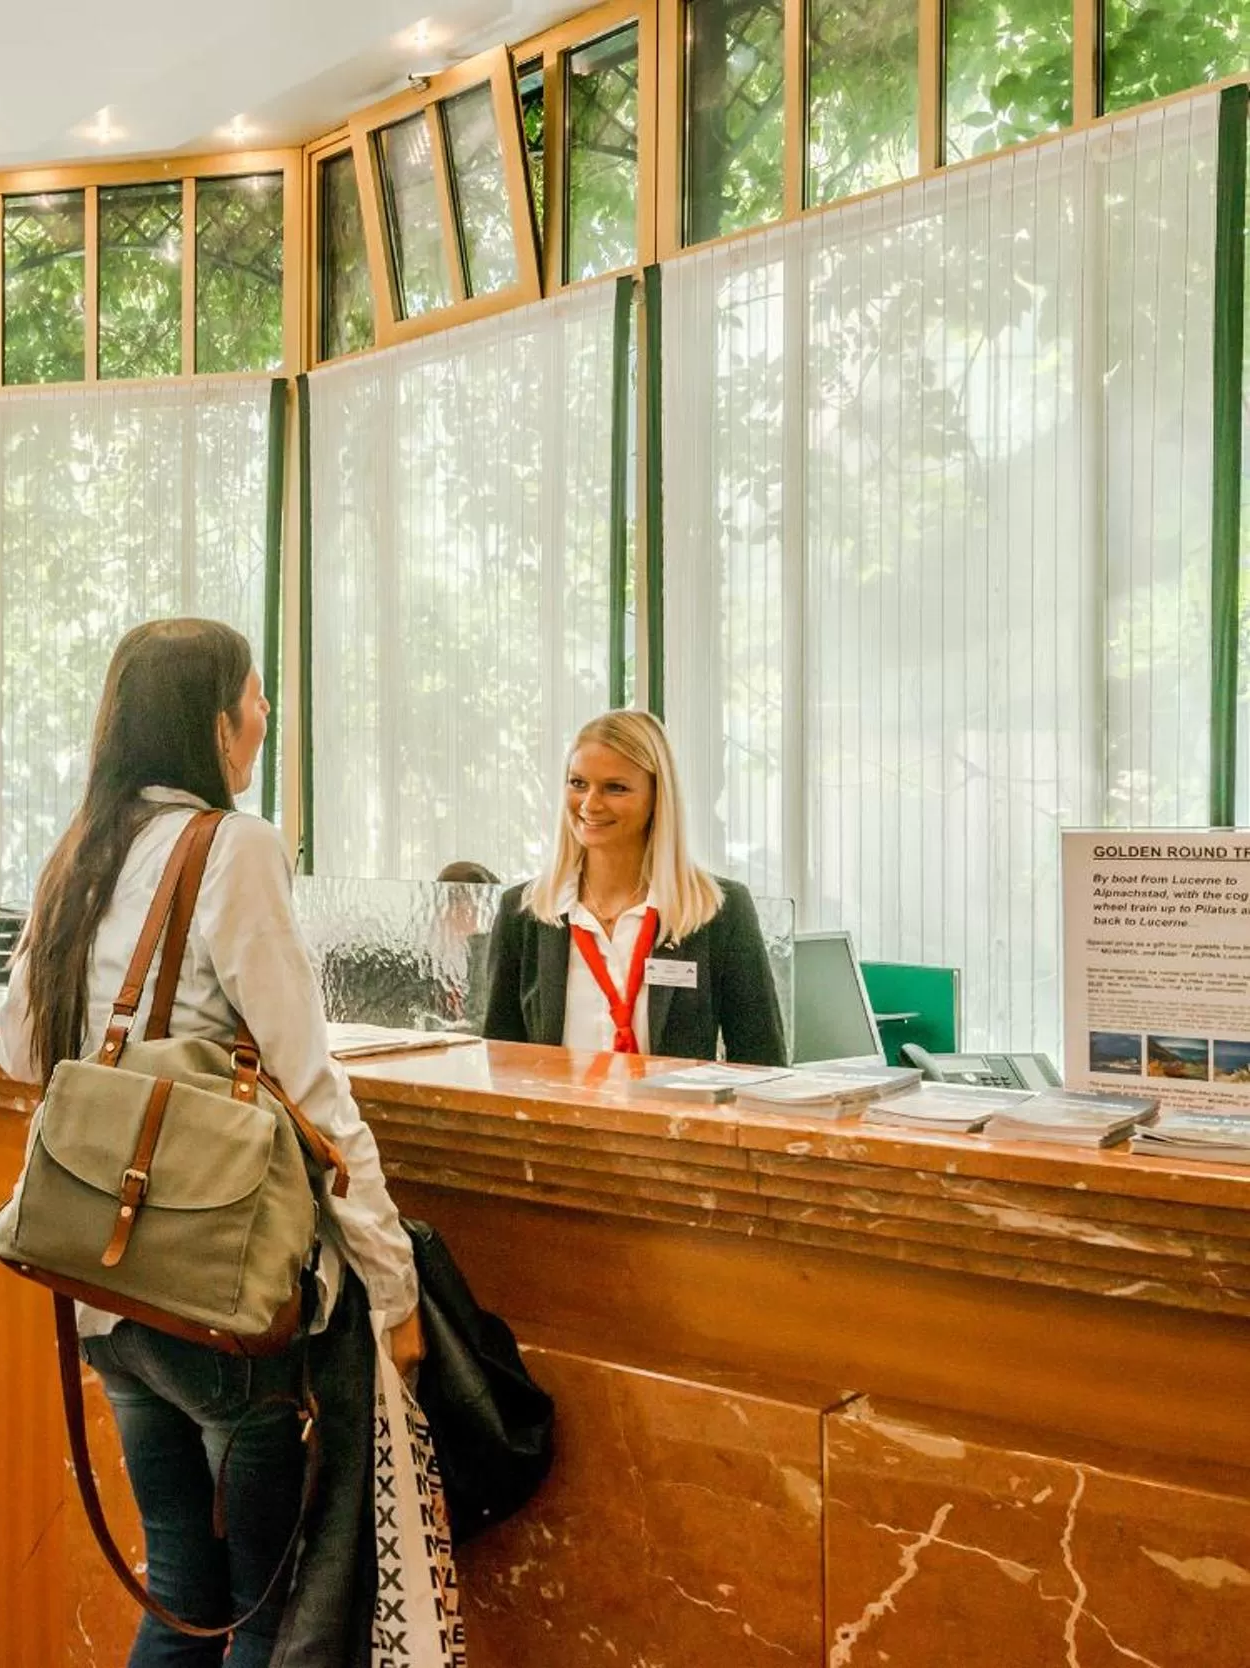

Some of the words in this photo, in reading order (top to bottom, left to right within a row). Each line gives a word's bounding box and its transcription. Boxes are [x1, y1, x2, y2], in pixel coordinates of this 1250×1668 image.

[1093, 846, 1161, 858] GOLDEN
[1167, 846, 1228, 858] ROUND
[1093, 874, 1109, 885] By
[1112, 874, 1137, 884] boat
[1141, 875, 1168, 884] from
[1172, 876, 1221, 885] Lucerne
[1225, 876, 1238, 885] to
[1173, 889, 1198, 899] with
[1202, 890, 1222, 899] the
[1225, 892, 1249, 902] cog
[1093, 903, 1127, 911] wheel
[1131, 904, 1157, 913] train
[1161, 905, 1176, 915] up
[1179, 904, 1191, 913] to
[1194, 904, 1236, 915] Pilatus
[1093, 916, 1120, 925] back
[1125, 917, 1136, 926] to
